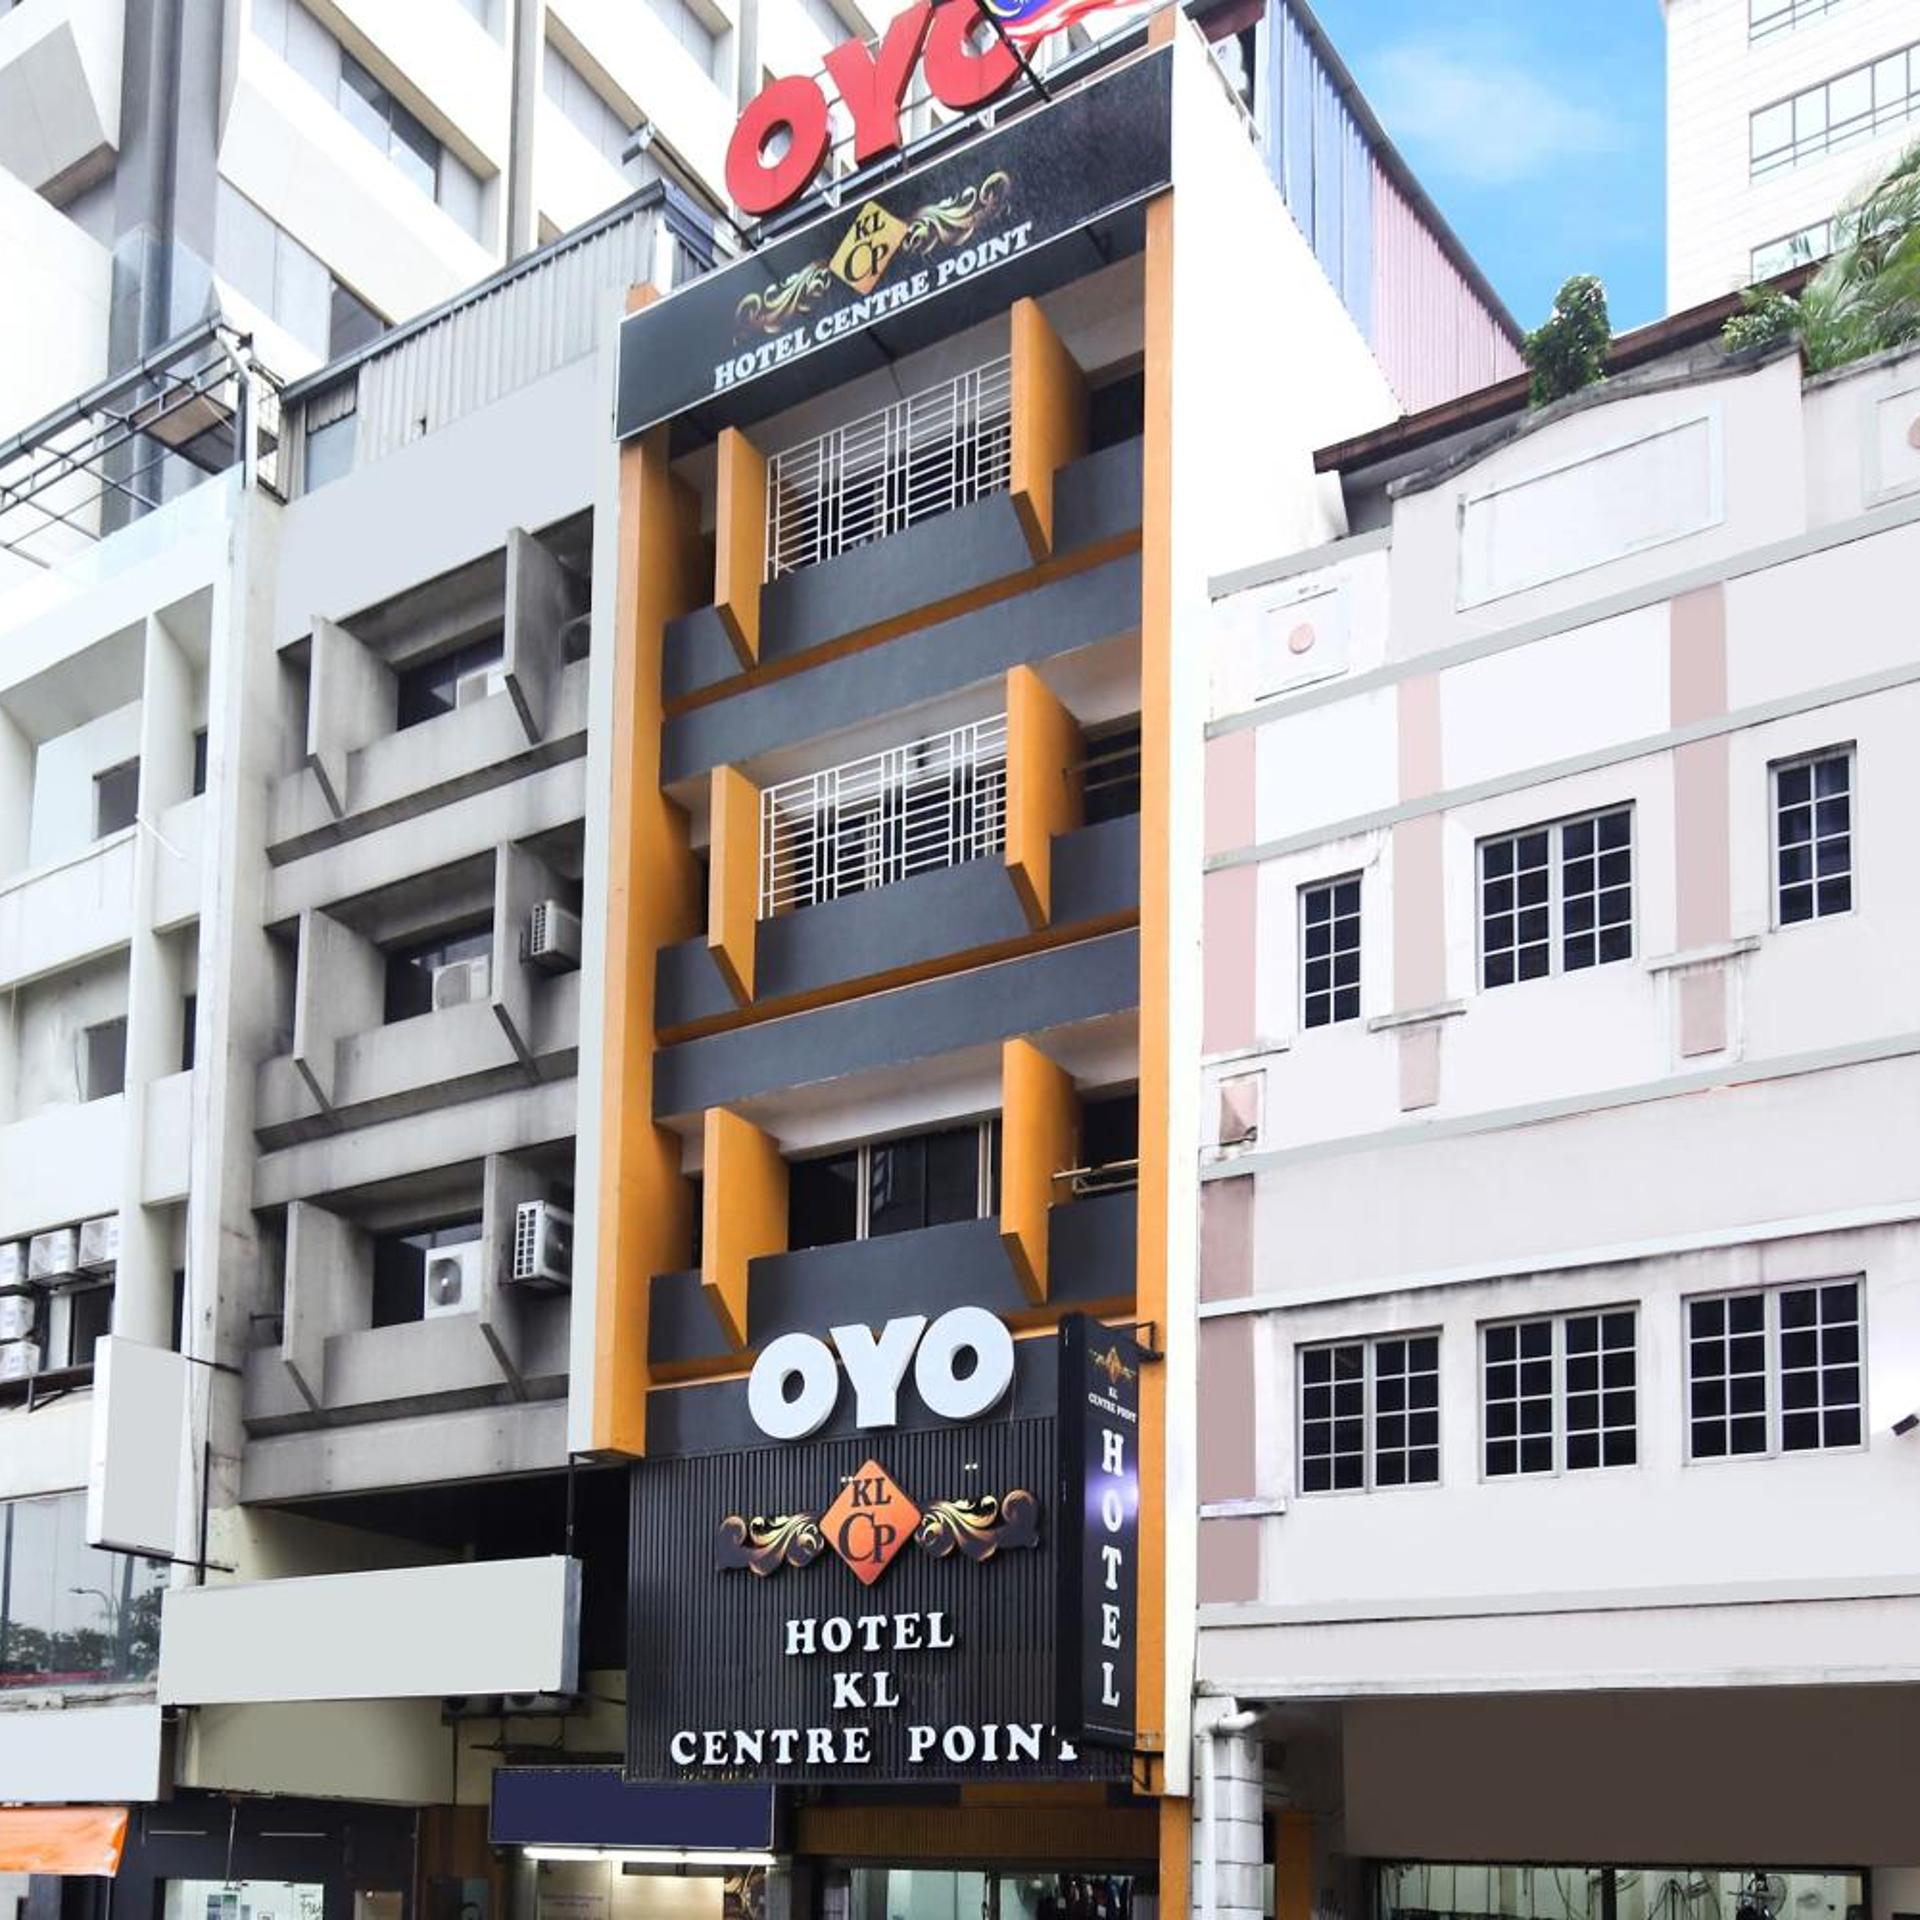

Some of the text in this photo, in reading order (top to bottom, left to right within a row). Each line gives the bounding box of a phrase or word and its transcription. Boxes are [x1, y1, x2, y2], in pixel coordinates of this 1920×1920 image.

[855, 210, 886, 242] KL
[844, 240, 889, 282] CP
[714, 221, 1032, 390] HOTEL CENTRE POINT
[748, 1306, 1015, 1440] OYO
[851, 1477, 892, 1507] KL
[838, 1512, 896, 1564] CP
[1101, 1428, 1124, 1707] HOTEL
[785, 1612, 954, 1655] HOTEL
[833, 1672, 900, 1708] KL
[670, 1727, 871, 1765] CENTRE
